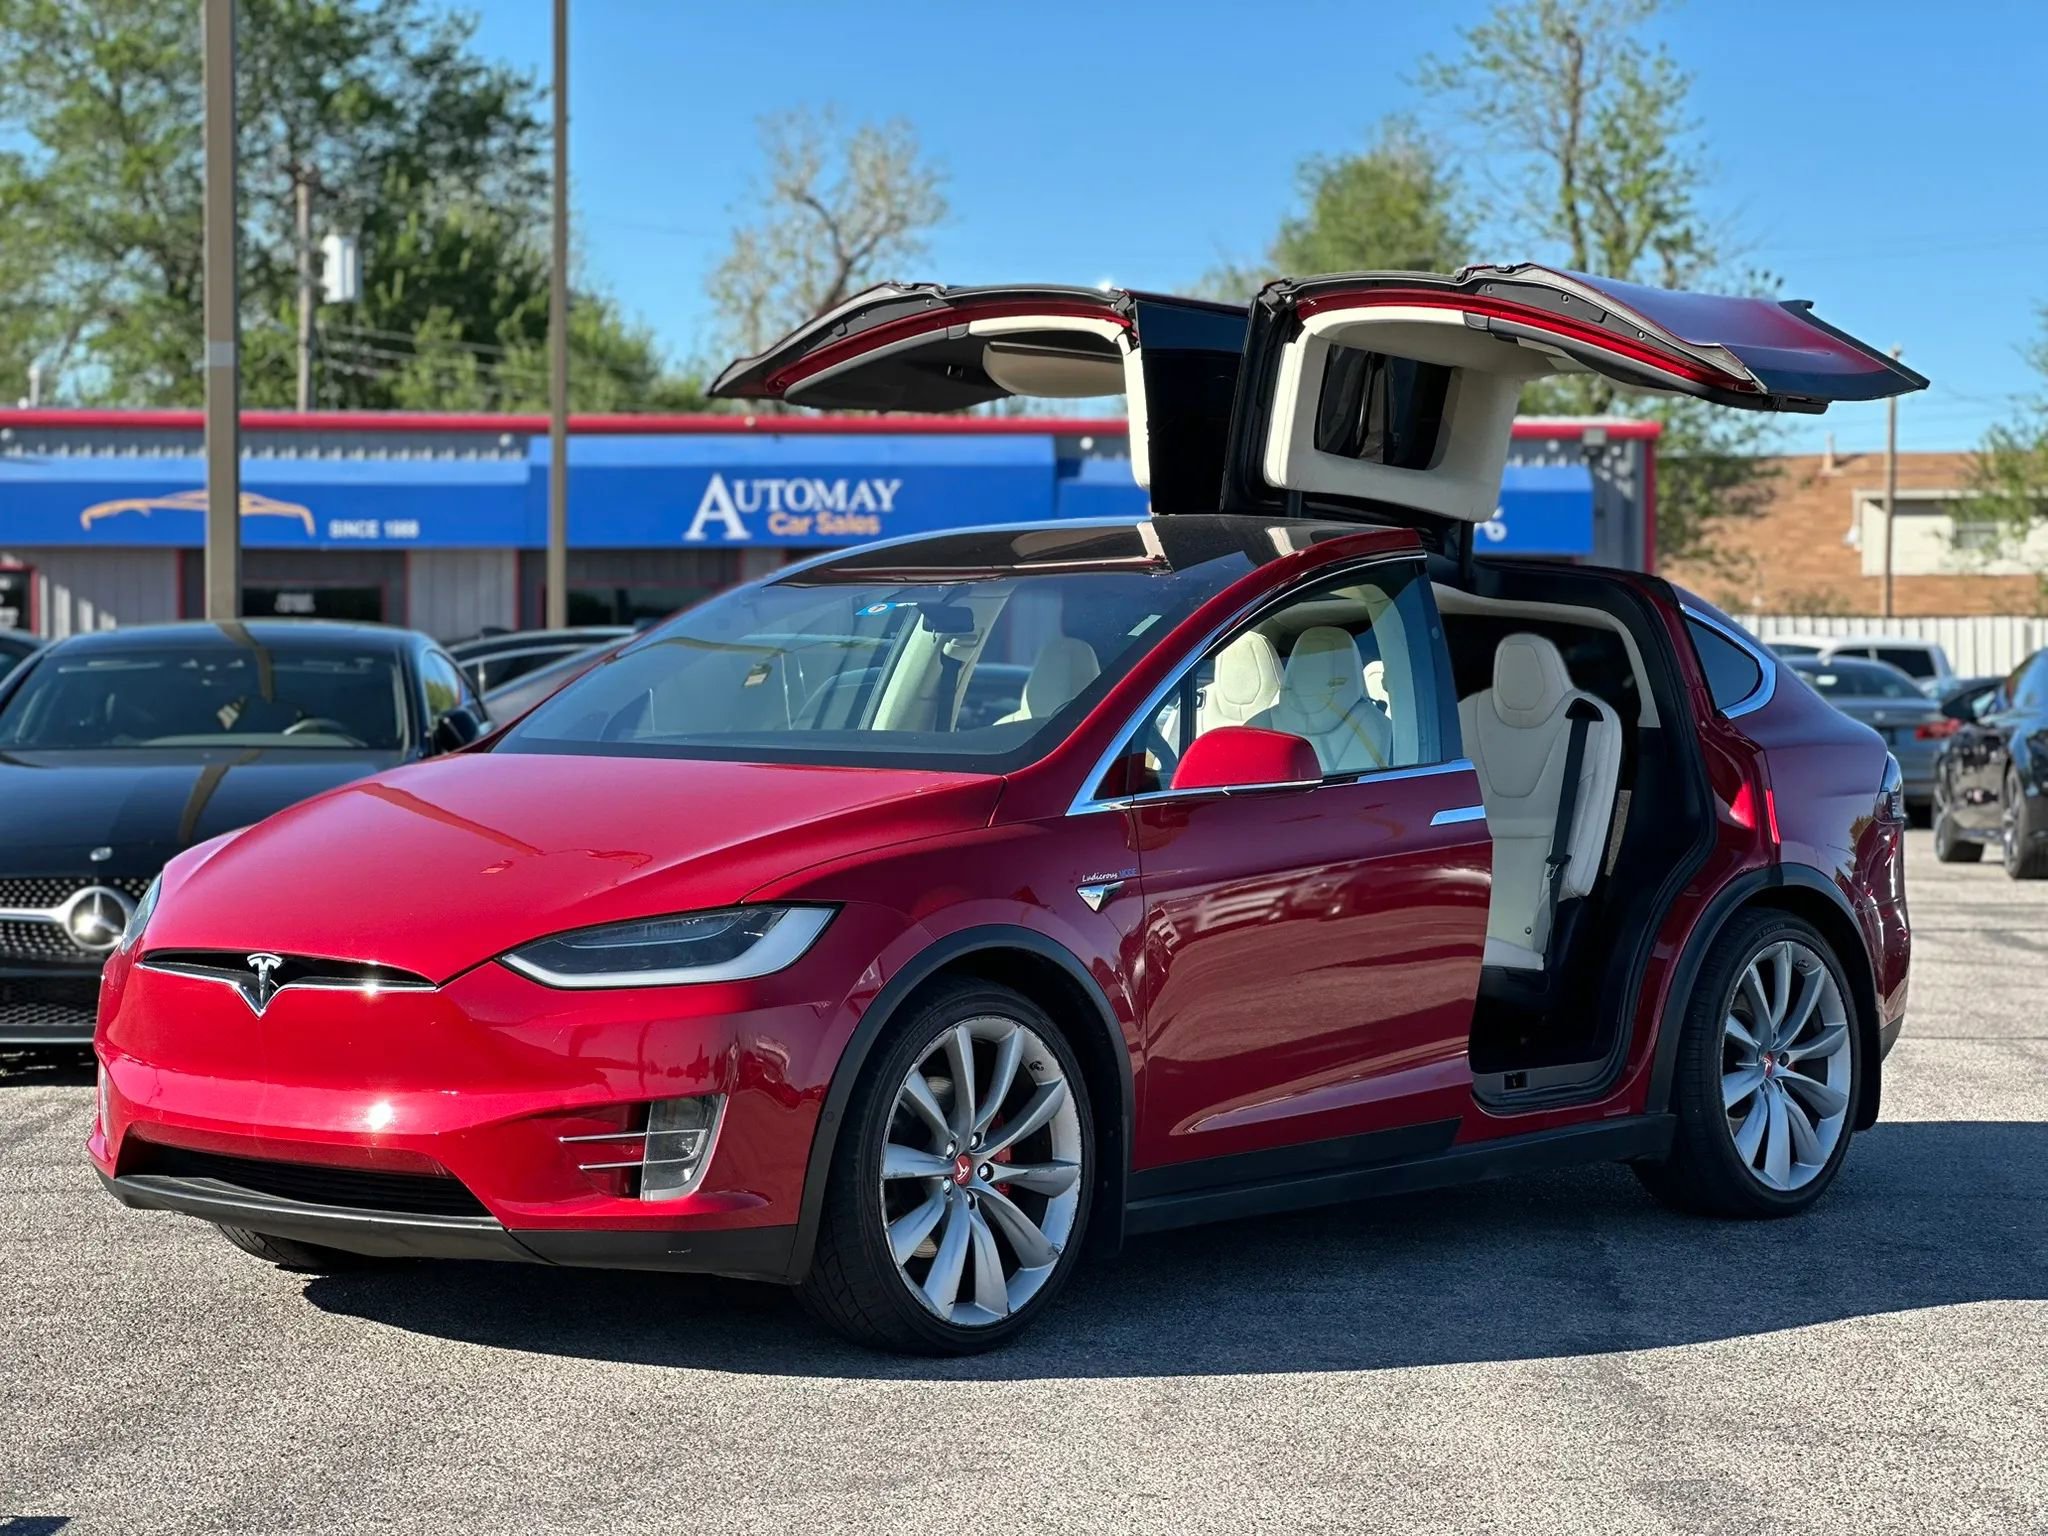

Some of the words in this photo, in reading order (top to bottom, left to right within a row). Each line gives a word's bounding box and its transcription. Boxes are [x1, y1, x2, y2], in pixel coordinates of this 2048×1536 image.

[683, 472, 902, 541] AUTOMAY
[328, 519, 379, 539] SINCE
[767, 512, 811, 536] Car
[816, 511, 881, 536] Sales
